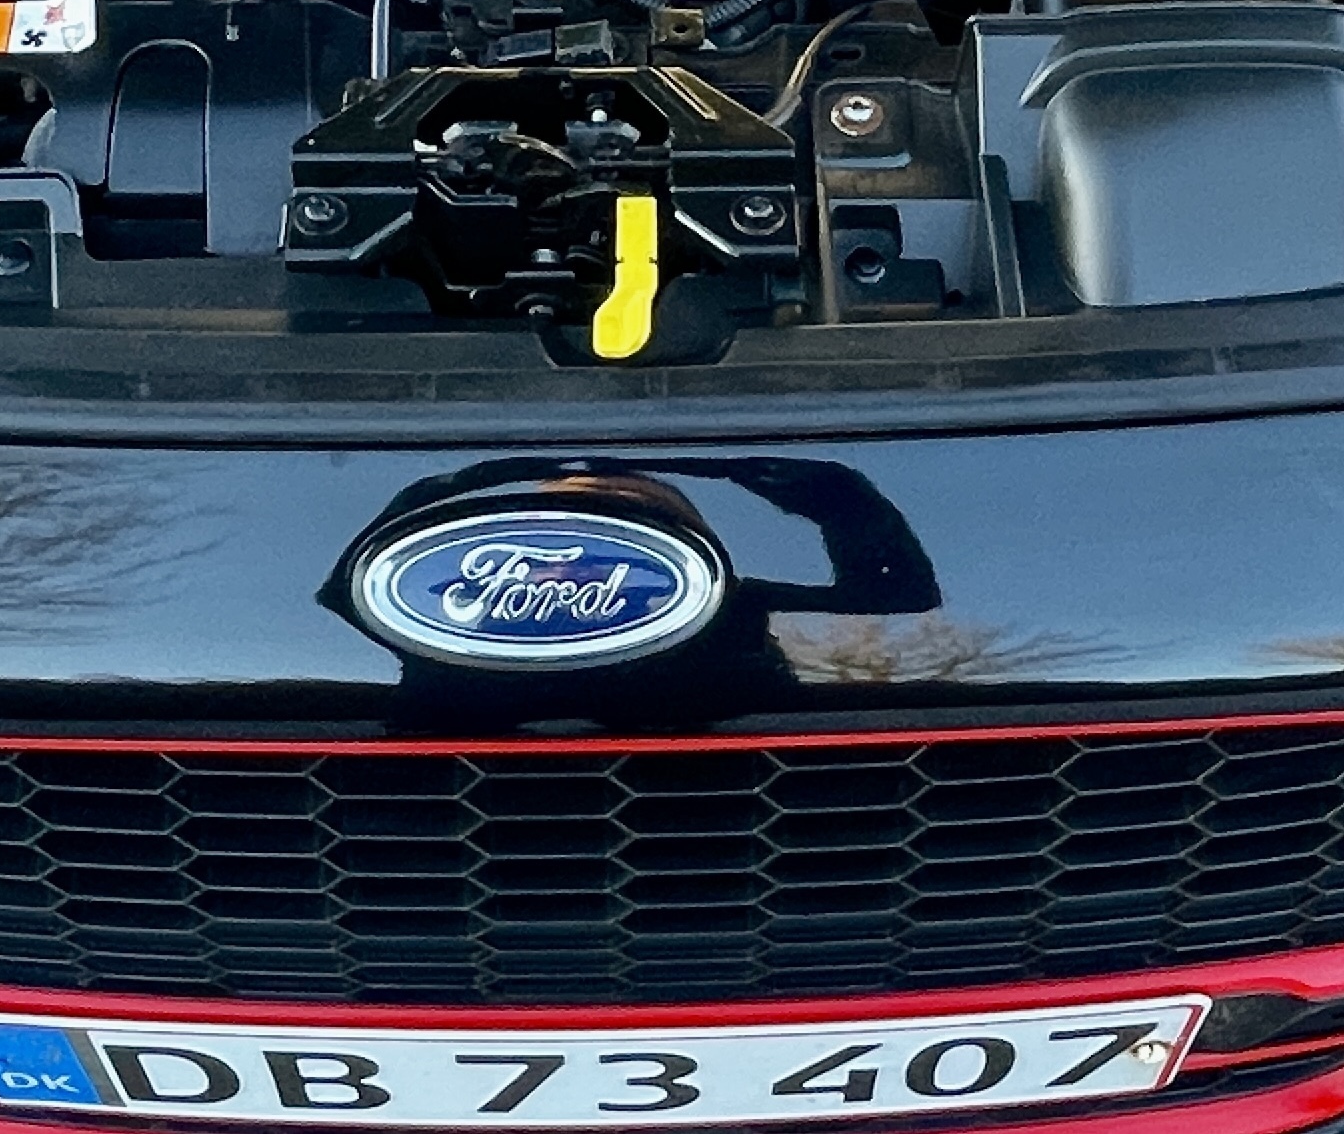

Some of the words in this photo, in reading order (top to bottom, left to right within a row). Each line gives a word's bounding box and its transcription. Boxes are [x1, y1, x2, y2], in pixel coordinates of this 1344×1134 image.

[442, 543, 629, 622] Ford
[2, 1071, 79, 1093] DK
[102, 1044, 392, 1110] DB
[456, 1053, 701, 1113] 73
[772, 1022, 1158, 1102] 407
